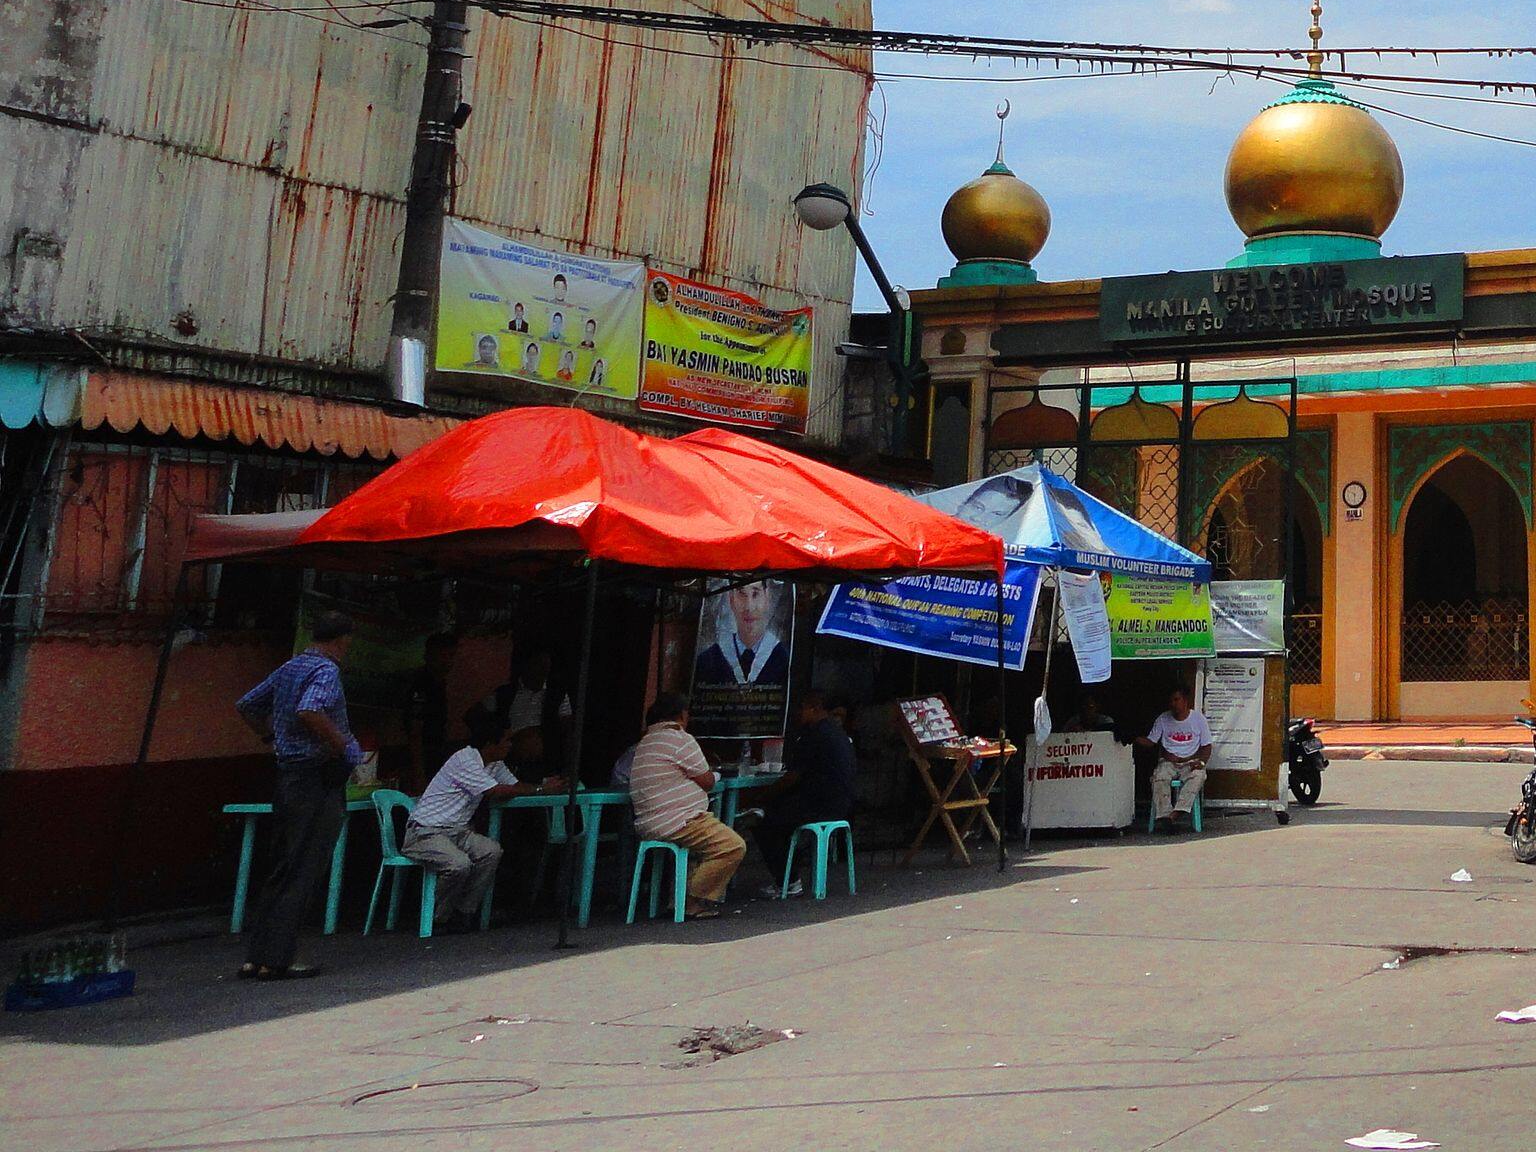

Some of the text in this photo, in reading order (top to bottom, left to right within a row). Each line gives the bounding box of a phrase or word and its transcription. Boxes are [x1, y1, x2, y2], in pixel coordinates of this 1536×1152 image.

[1213, 264, 1345, 294] WELCOME
[676, 284, 740, 310] ALHAMDULILLAH
[1127, 297, 1212, 321] MANILA
[1332, 281, 1432, 309] MOSQUE
[675, 300, 710, 319] President
[712, 311, 746, 328] BENIGNO
[1185, 319, 1196, 331] &
[713, 333, 724, 344] the
[647, 340, 807, 388] BAI YASMIN PANDAO BUSRAN
[642, 391, 678, 406] COMPL.
[696, 401, 729, 416] HESHAM
[731, 406, 766, 420] SHARIEF
[1076, 552, 1195, 578] MUSLIM VOLUNTEER BRIGADE
[896, 574, 932, 592] IPANTS,
[932, 576, 979, 595] DELEGATES
[980, 584, 986, 595] &
[866, 589, 901, 608] NATIONAL
[930, 604, 962, 619] READING
[963, 606, 1015, 626] COMPETITON
[1118, 620, 1144, 633] ALMEL
[1154, 619, 1208, 633] MANGANDOG
[1046, 743, 1093, 758] SECURITY
